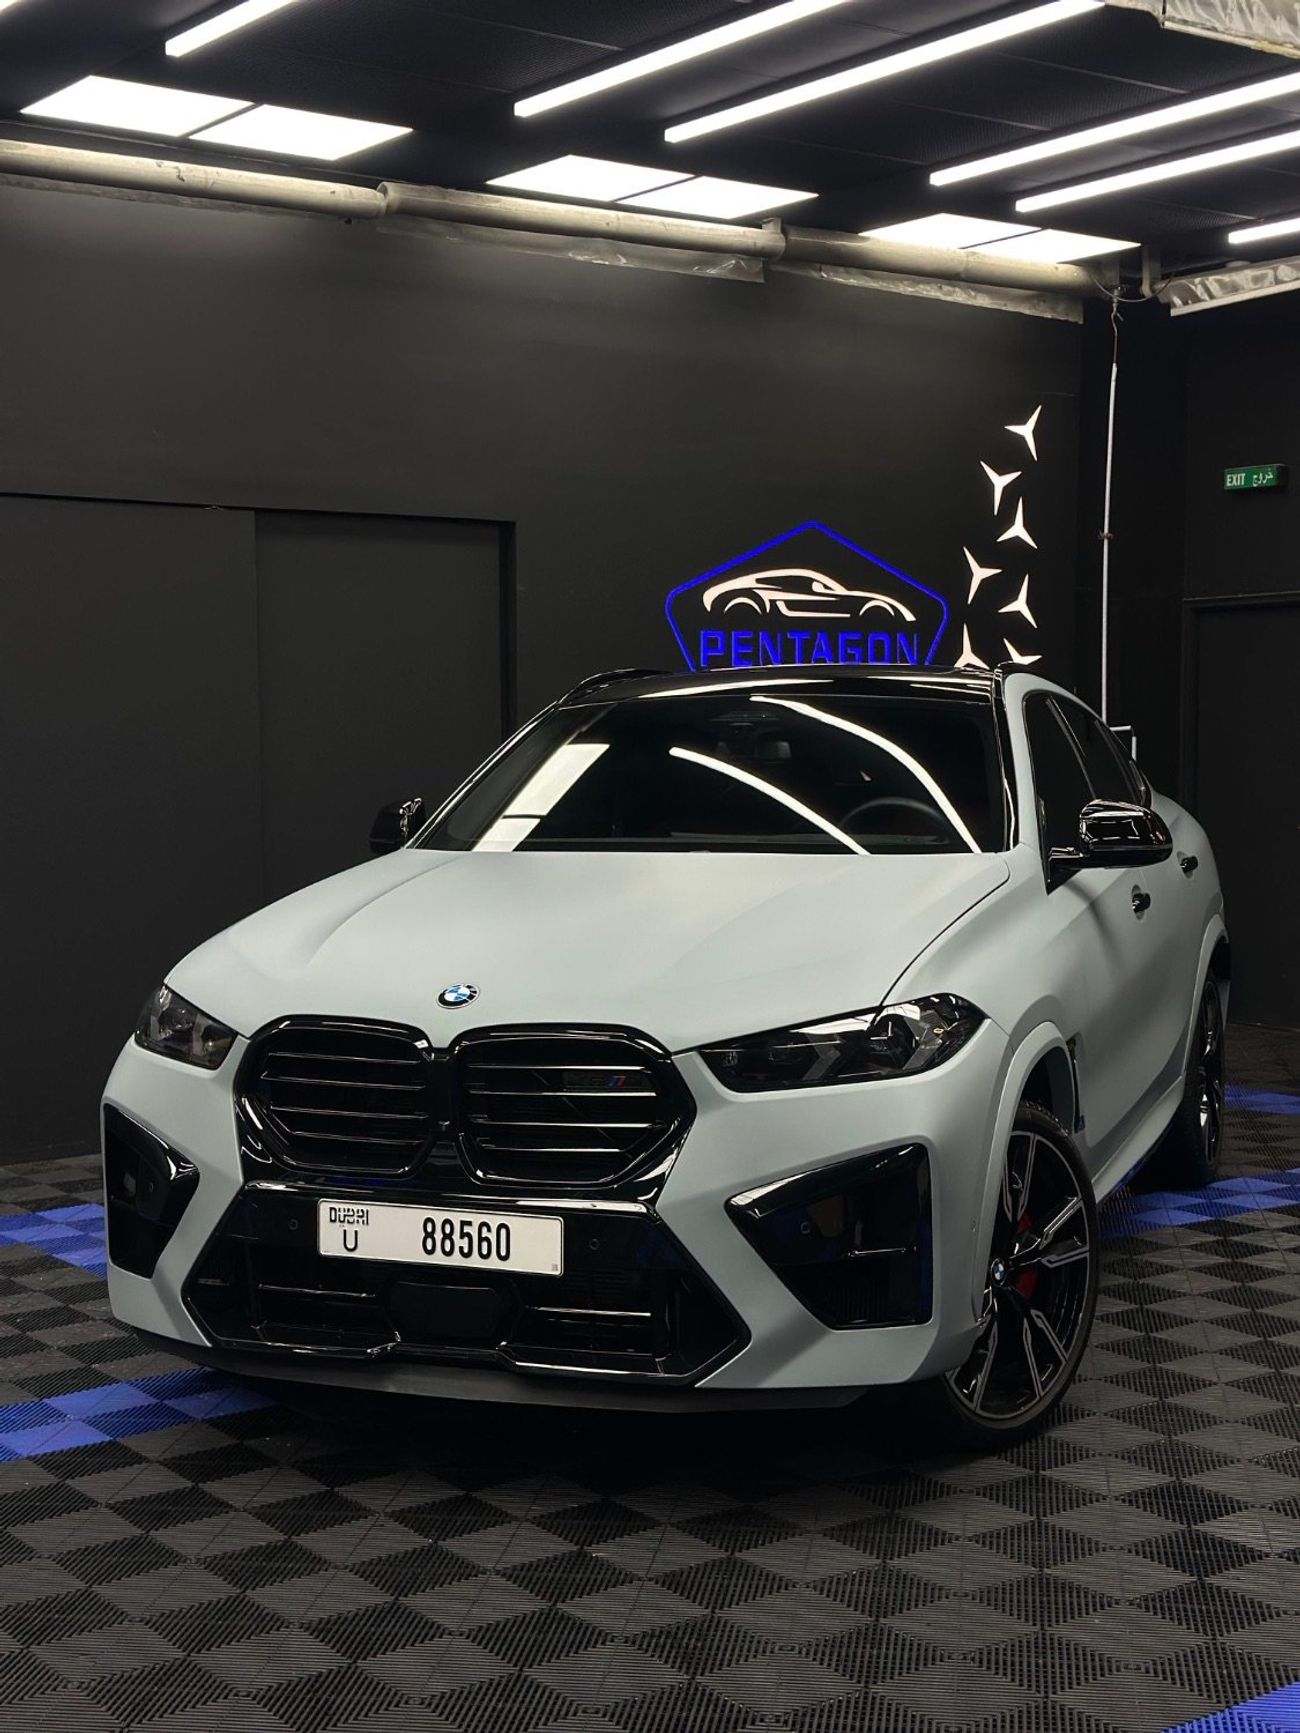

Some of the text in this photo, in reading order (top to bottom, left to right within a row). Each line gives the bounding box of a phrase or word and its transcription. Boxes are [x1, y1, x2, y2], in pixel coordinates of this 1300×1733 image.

[1226, 473, 1246, 487] EXIT
[1252, 468, 1274, 487] خروج
[700, 630, 918, 667] PENTAGON
[329, 1206, 369, 1226] DUBAI
[343, 1216, 511, 1262] U 88560
